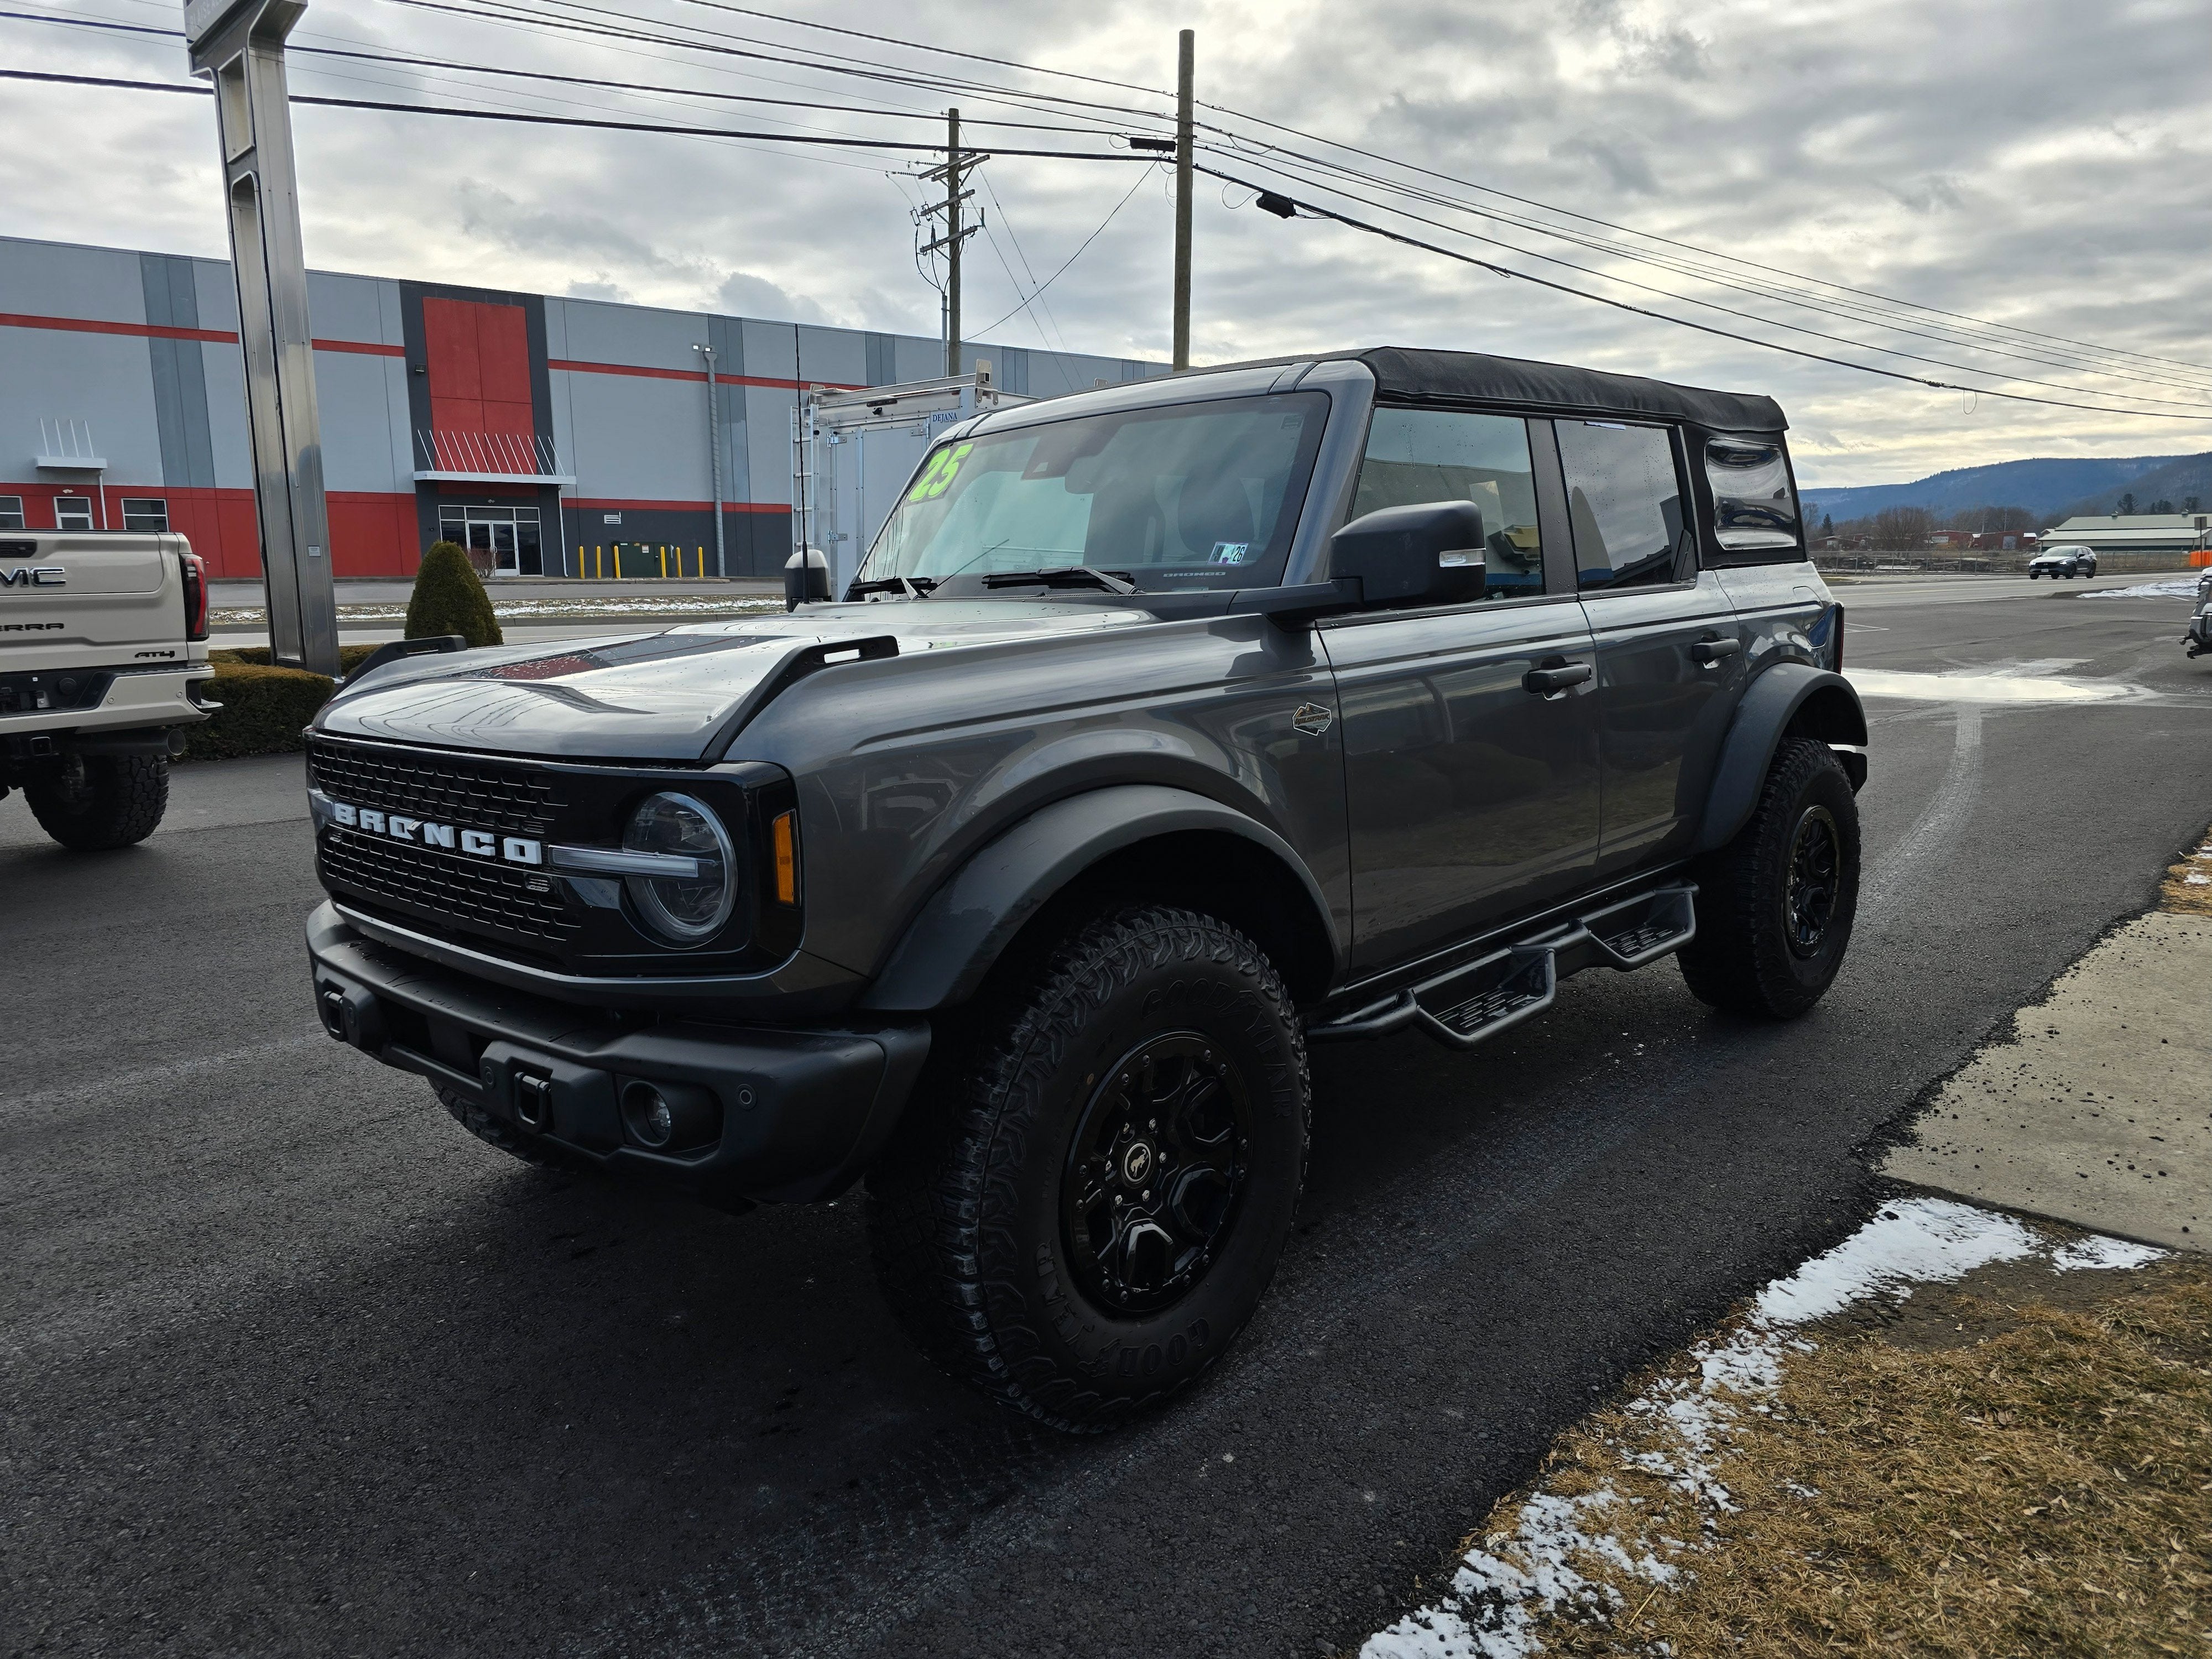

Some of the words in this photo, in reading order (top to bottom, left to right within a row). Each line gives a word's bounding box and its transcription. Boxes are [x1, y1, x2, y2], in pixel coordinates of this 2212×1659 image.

[932, 412, 957, 423] DEJANA
[908, 444, 973, 502] 25
[1232, 546, 1245, 562] 26
[335, 802, 542, 864] BRONCO
